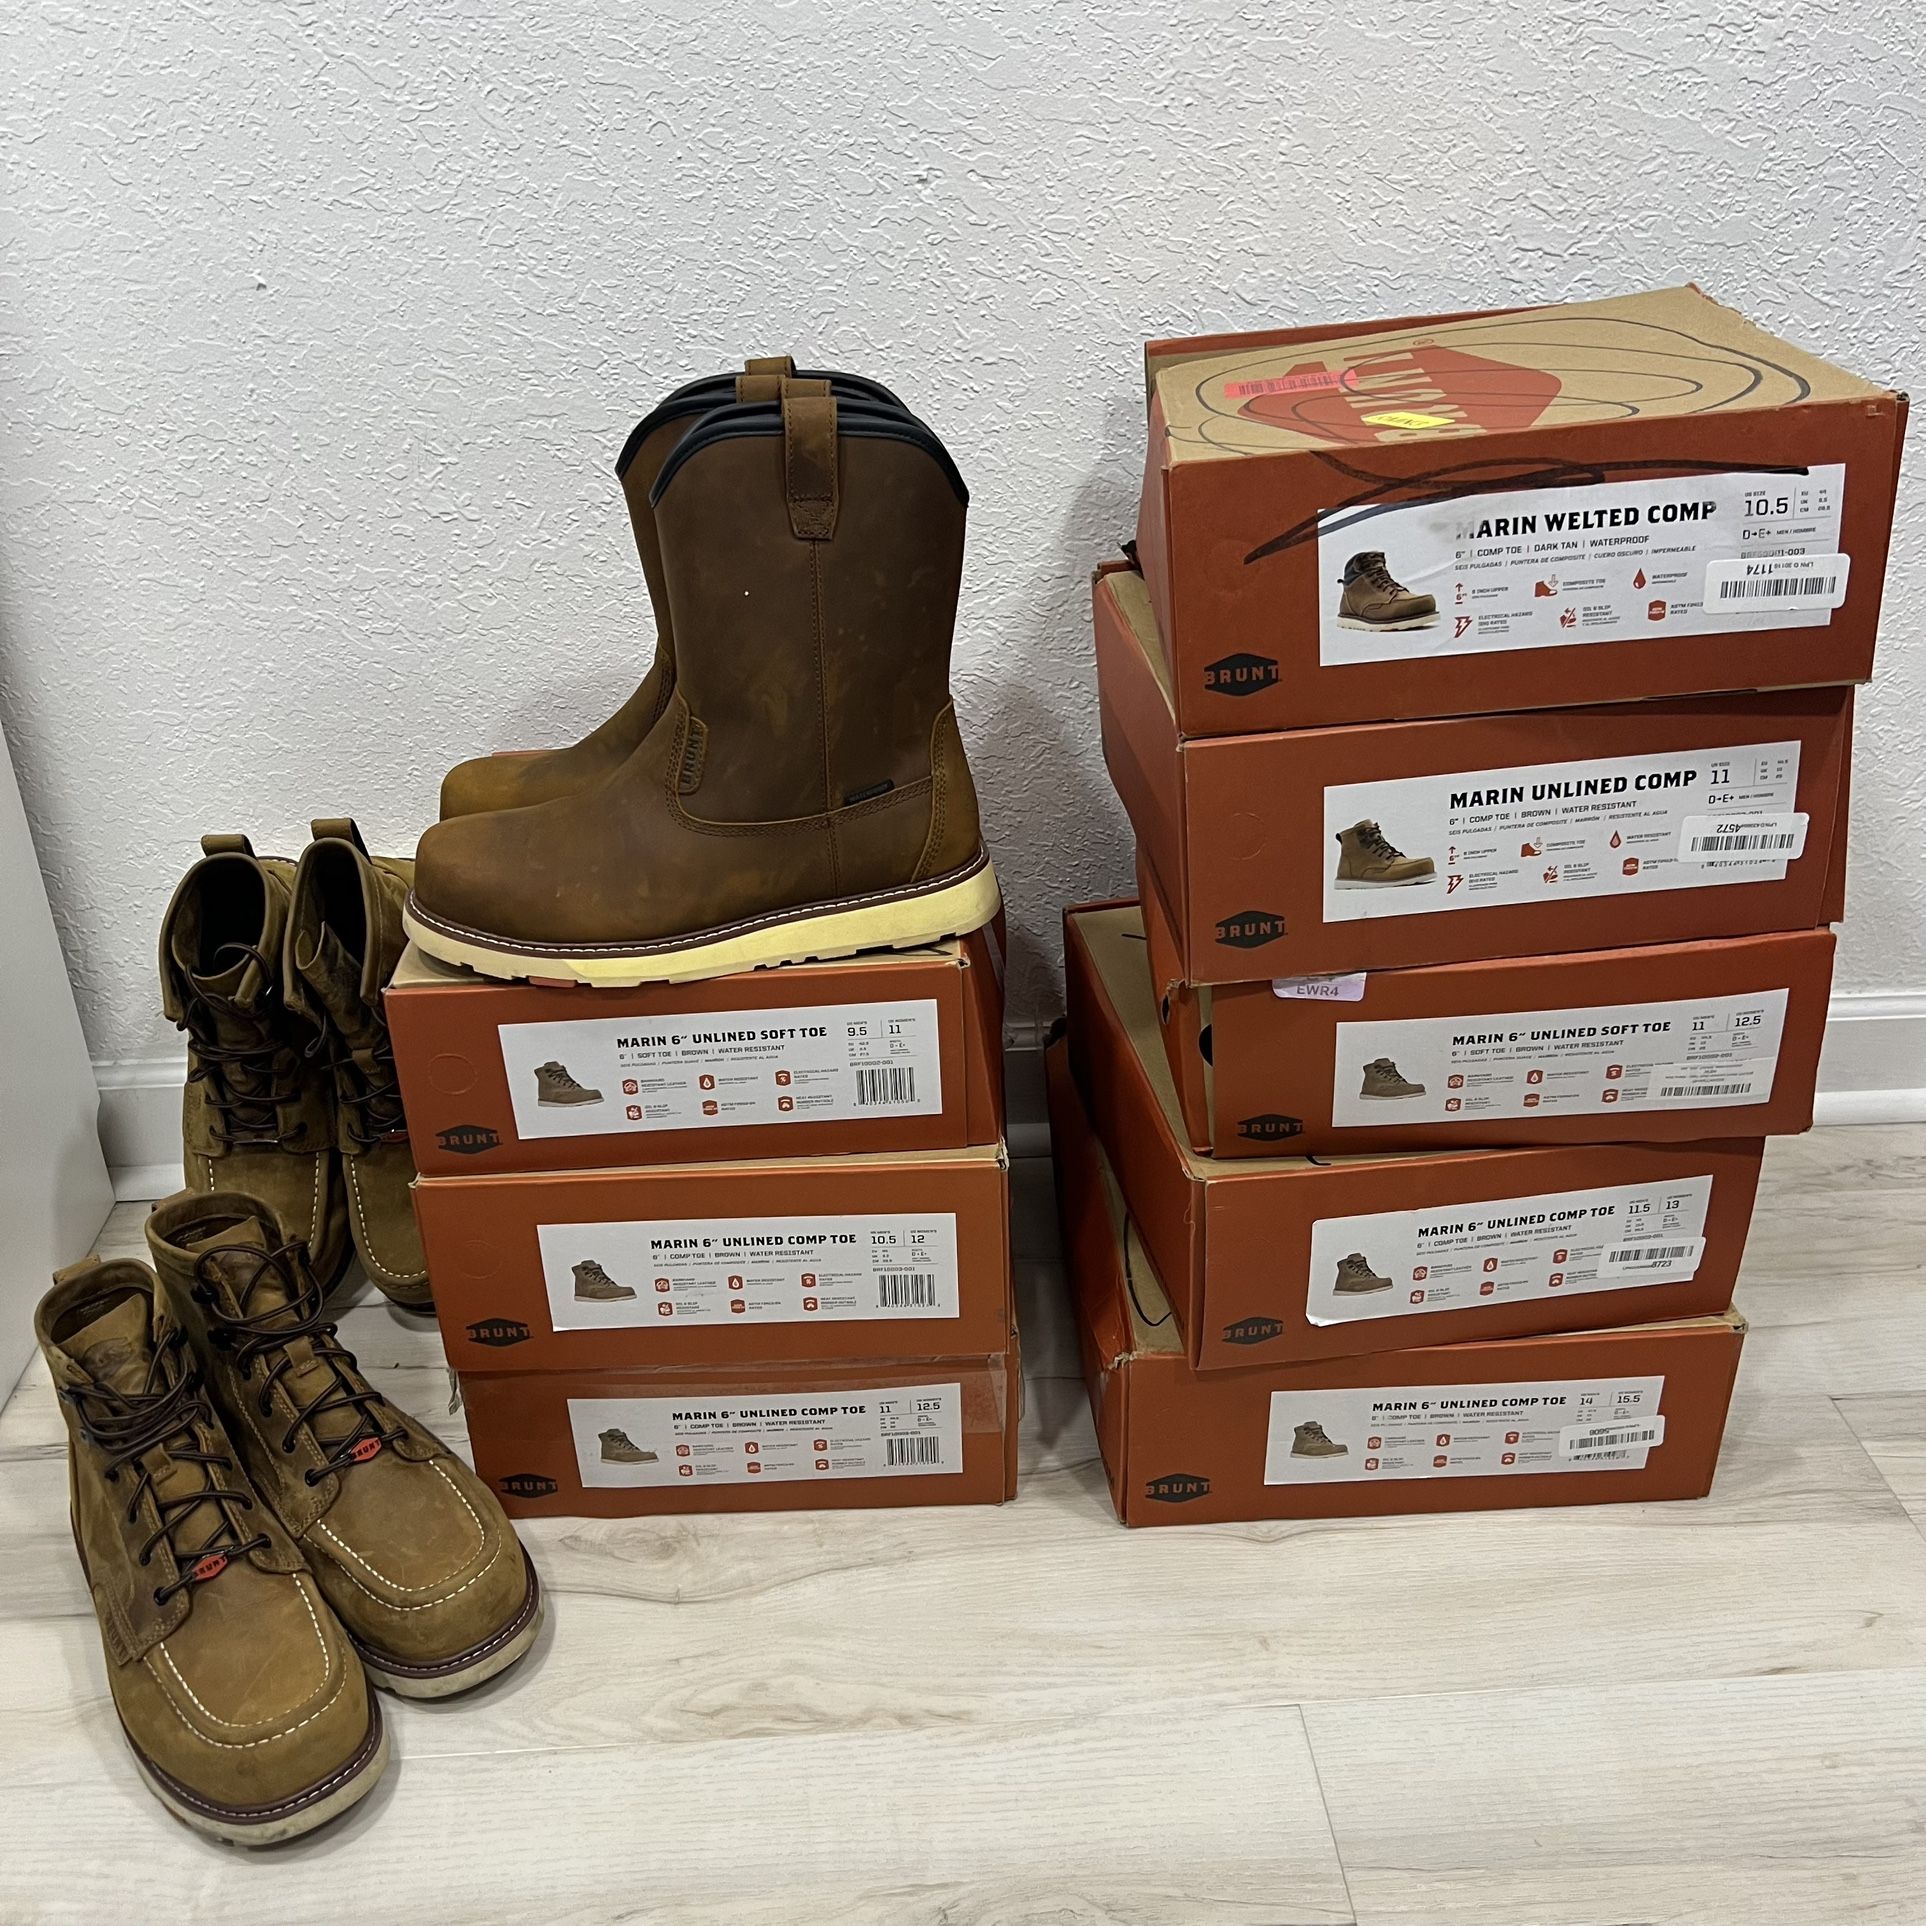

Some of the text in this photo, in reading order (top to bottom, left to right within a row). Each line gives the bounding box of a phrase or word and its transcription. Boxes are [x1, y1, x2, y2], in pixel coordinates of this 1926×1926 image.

[1744, 497, 1789, 517] 10.5
[1544, 507, 1640, 532] WELTED
[1648, 501, 1717, 524] COMP
[1477, 548, 1503, 557] COMP
[1506, 546, 1522, 555] TOE
[1534, 543, 1558, 552] DARK
[1561, 541, 1578, 549] TAN
[1590, 536, 1650, 547] WATERPROOF
[1470, 561, 1502, 570] PULGADAS
[1511, 558, 1539, 566] PUNTERA
[1550, 554, 1585, 562] COMPOSITE
[1651, 546, 1696, 554] IMPERMEABLE
[1746, 564, 1773, 575] 1174
[1205, 664, 1278, 685] BRUNT
[1711, 769, 1730, 785] 11
[1450, 770, 1698, 809] MARIN UNLINED COMP
[1470, 814, 1493, 824] COMP
[1521, 809, 1551, 818] BROWN
[1562, 805, 1589, 814] WATER
[1591, 801, 1637, 811] RESISTANT
[1462, 826, 1491, 835] PULGADAS
[1500, 823, 1525, 831] PUNTERA
[1536, 819, 1567, 827] COMPOSITE
[1717, 824, 1742, 833] 4572
[1215, 921, 1285, 939] BRUNT
[1296, 984, 1339, 997] EWR4
[1692, 1015, 1761, 1031] 11 12.5
[617, 1036, 667, 1048] MARIN
[693, 1031, 756, 1044] UNLINED
[760, 1029, 796, 1040] SOFT
[799, 1027, 827, 1038] TOE
[847, 1025, 901, 1037] 9.5 11
[1452, 1033, 1504, 1046] MARIN
[1531, 1027, 1596, 1041] UNLINED
[1601, 1024, 1639, 1036] SOFT
[1643, 1022, 1671, 1033] TOE
[745, 1045, 785, 1053] RESISTANT
[1516, 1045, 1544, 1053] BROWN
[1554, 1043, 1580, 1051] WATER
[1581, 1040, 1624, 1049] RESISTANT
[1239, 1122, 1303, 1134] BRUNT
[438, 1131, 500, 1146] BRUNT
[1628, 1201, 1680, 1214] 11.5 13
[1418, 1224, 1464, 1238] MARIN
[1487, 1214, 1546, 1229] UNLINED
[1550, 1210, 1587, 1222] COMP
[1591, 1206, 1615, 1217] TOE
[651, 1239, 698, 1250] MARIN
[723, 1236, 784, 1247] UNLINED
[788, 1235, 827, 1245] COMP
[831, 1235, 856, 1244] TOE
[872, 1235, 925, 1245] 10.5 12
[1434, 1239, 1454, 1247] COMP
[1477, 1233, 1502, 1242] BROWN
[1535, 1225, 1572, 1235] RESISTANT
[469, 1326, 530, 1339] BRUNT
[1223, 1323, 1283, 1339] BRUNT
[918, 1402, 940, 1411] 12.5
[1373, 1402, 1417, 1412] MARIN
[1440, 1399, 1498, 1409] UNLINED
[1502, 1398, 1539, 1407] COMP
[1543, 1397, 1567, 1405] TOE
[1617, 1395, 1641, 1403] 15.5
[673, 1412, 717, 1421] MARIN
[740, 1409, 797, 1419] UNLINED
[801, 1408, 838, 1416] COMP
[842, 1406, 867, 1414] TOE
[501, 1480, 557, 1490] BRUNT
[1145, 1480, 1209, 1494] BRUNT
